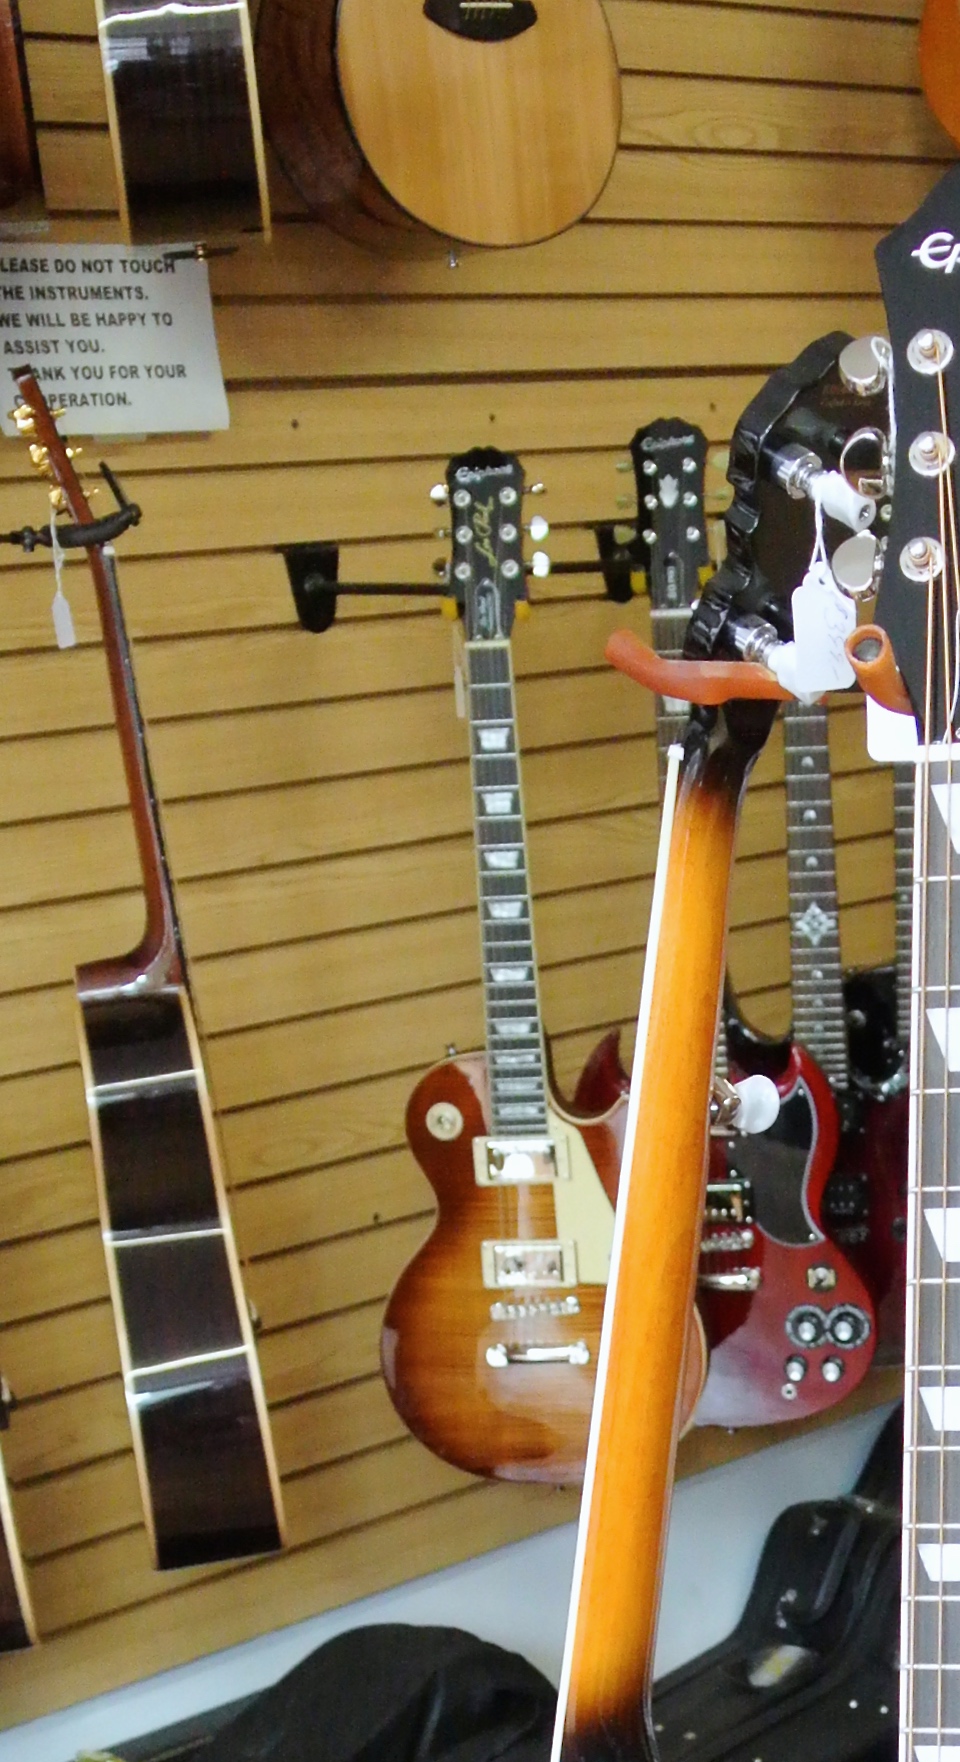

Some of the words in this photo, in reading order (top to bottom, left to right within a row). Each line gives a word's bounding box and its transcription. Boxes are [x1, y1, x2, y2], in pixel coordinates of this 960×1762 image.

[0, 257, 49, 273] LEASE
[55, 258, 76, 273] DO
[81, 258, 113, 273] NOT
[120, 257, 176, 274] TOUCH
[0, 285, 25, 300] HE
[29, 285, 149, 300] INSTRUMENTS.
[25, 312, 66, 327] WILL
[70, 312, 91, 327] BE
[95, 311, 147, 327] HAPPY
[153, 311, 174, 327] TO
[3, 339, 60, 354] ASSIST
[64, 338, 106, 353] YOU.
[8, 366, 66, 381] ANK
[70, 365, 104, 380] YOU
[109, 364, 140, 379] FOR
[146, 363, 187, 379] YOUR
[14, 391, 132, 408] CPERATION.
